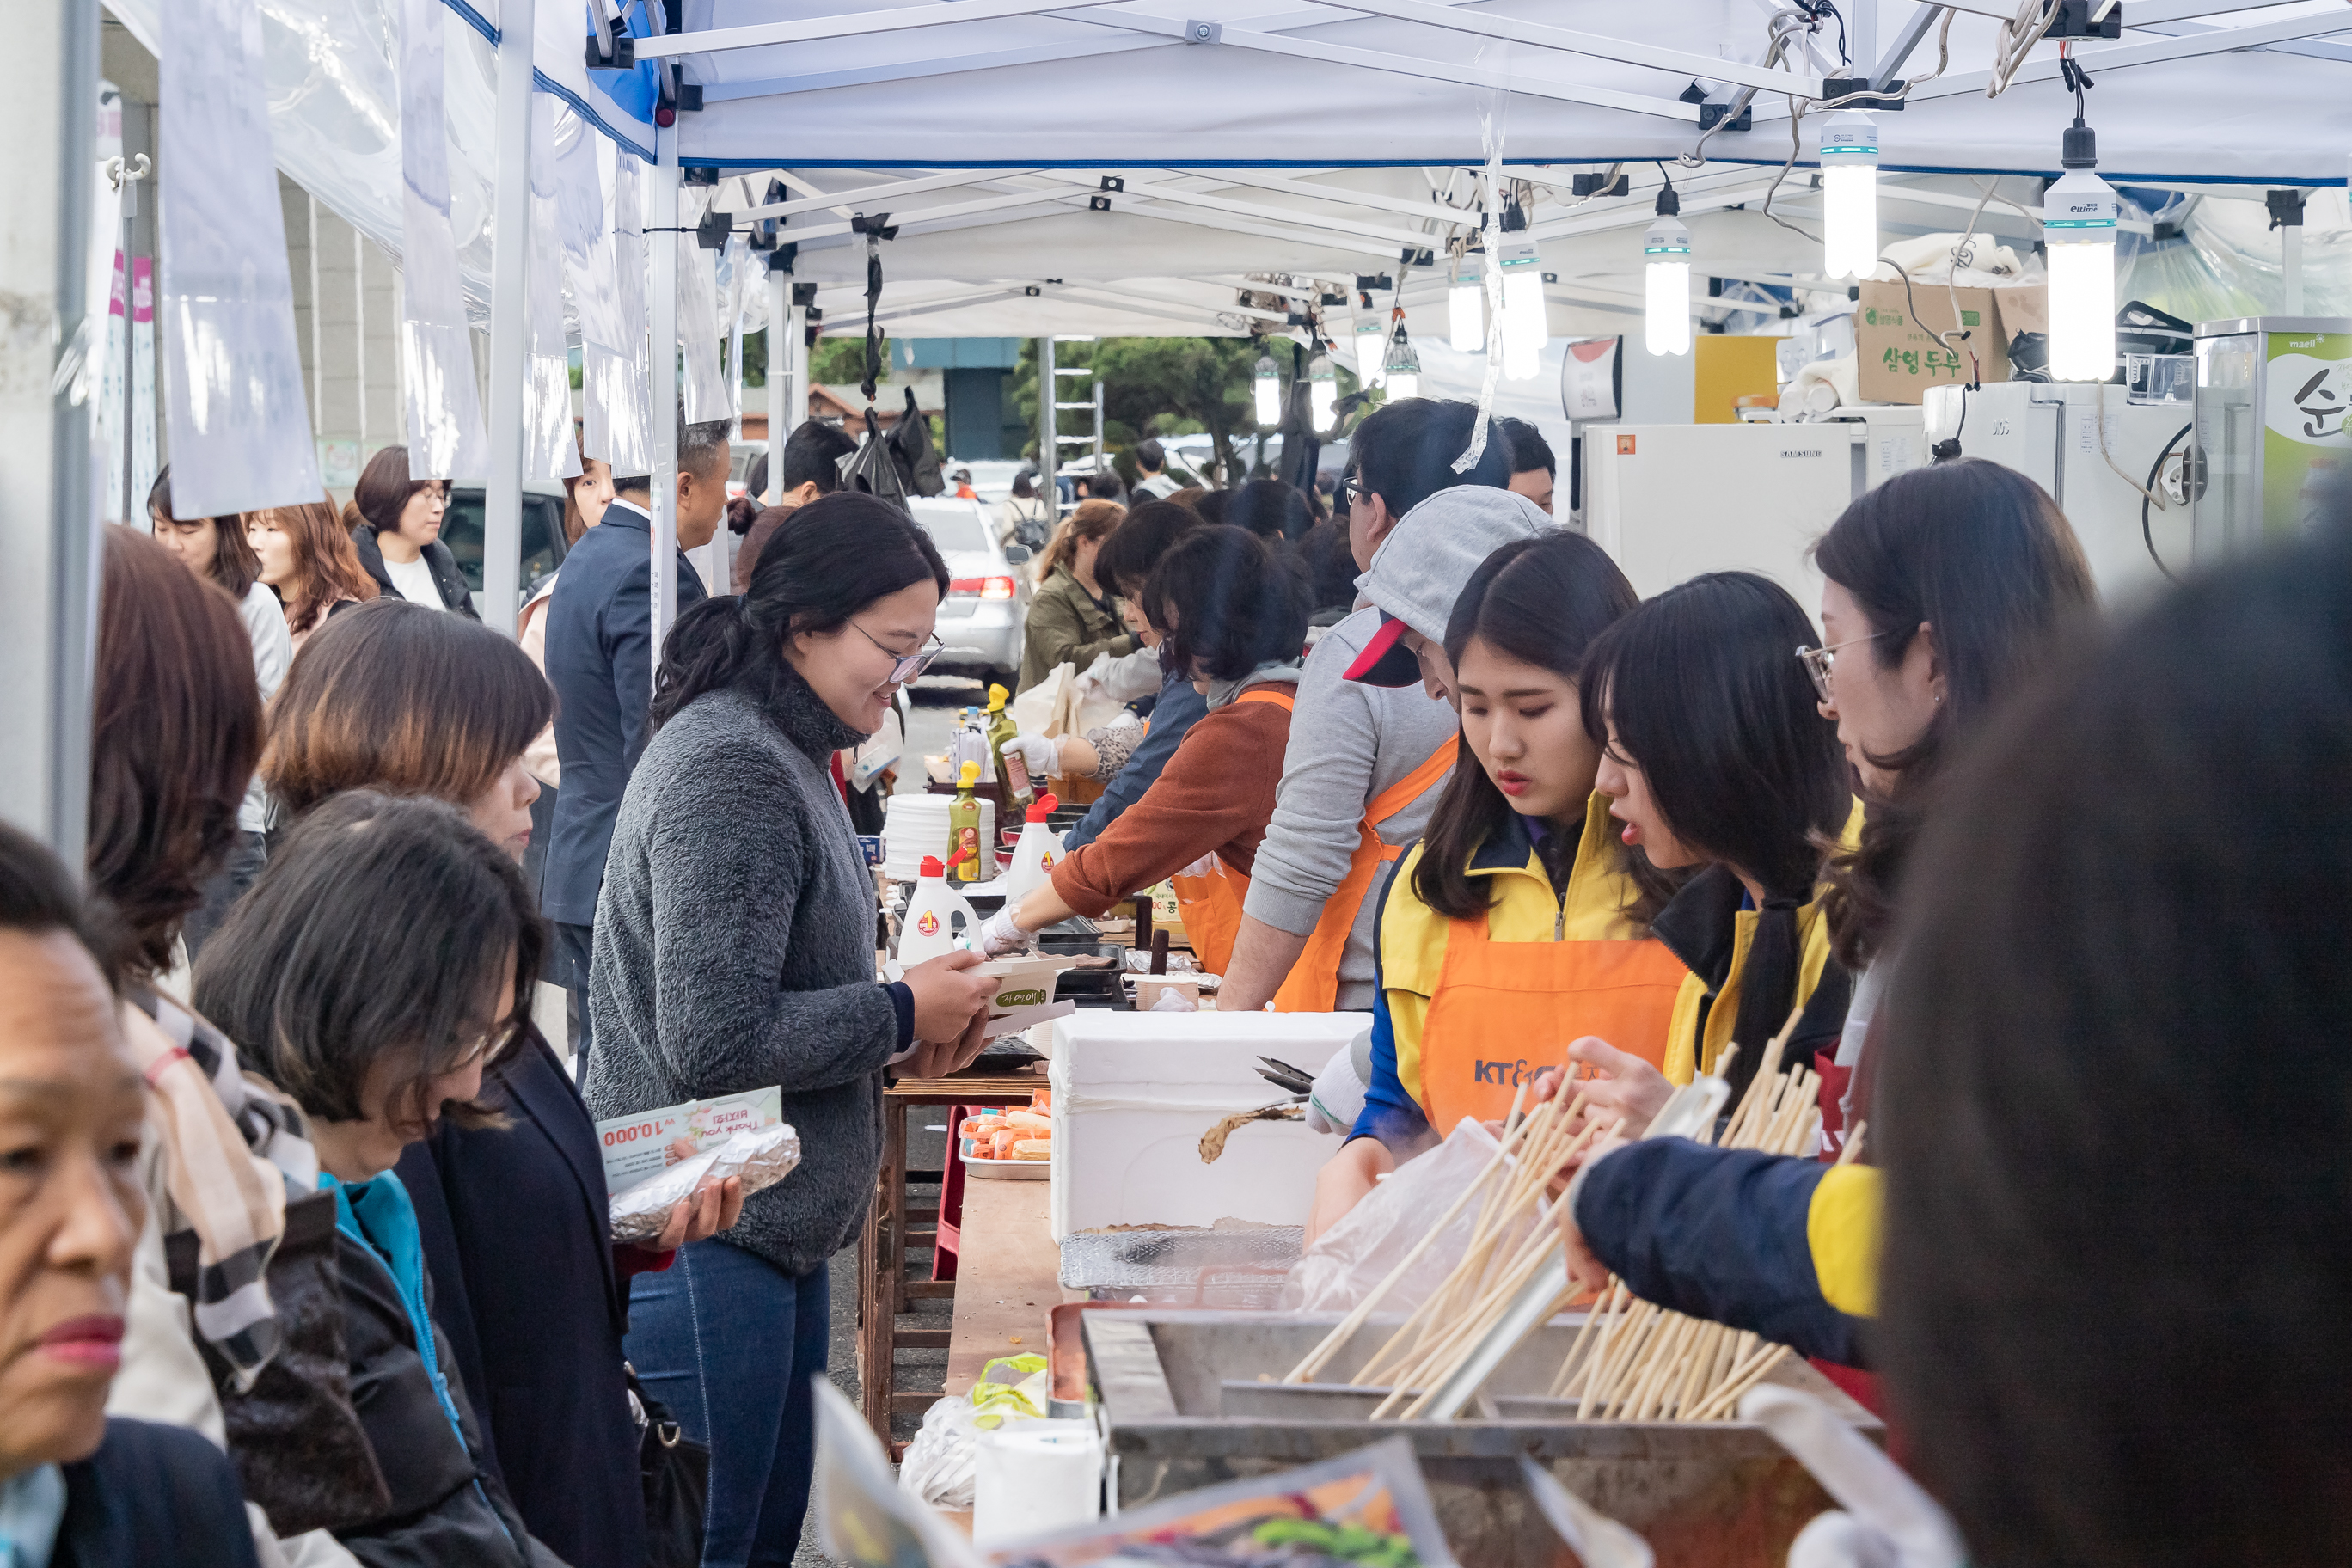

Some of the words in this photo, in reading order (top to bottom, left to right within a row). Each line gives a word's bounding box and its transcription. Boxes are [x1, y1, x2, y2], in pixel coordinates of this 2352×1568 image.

[1883, 346, 1919, 375] 삼영
[1924, 350, 1962, 378] 두부
[2294, 368, 2352, 438] 순
[1167, 901, 1177, 914] 콩
[713, 1109, 748, 1125] 바자회
[701, 1125, 722, 1137] you
